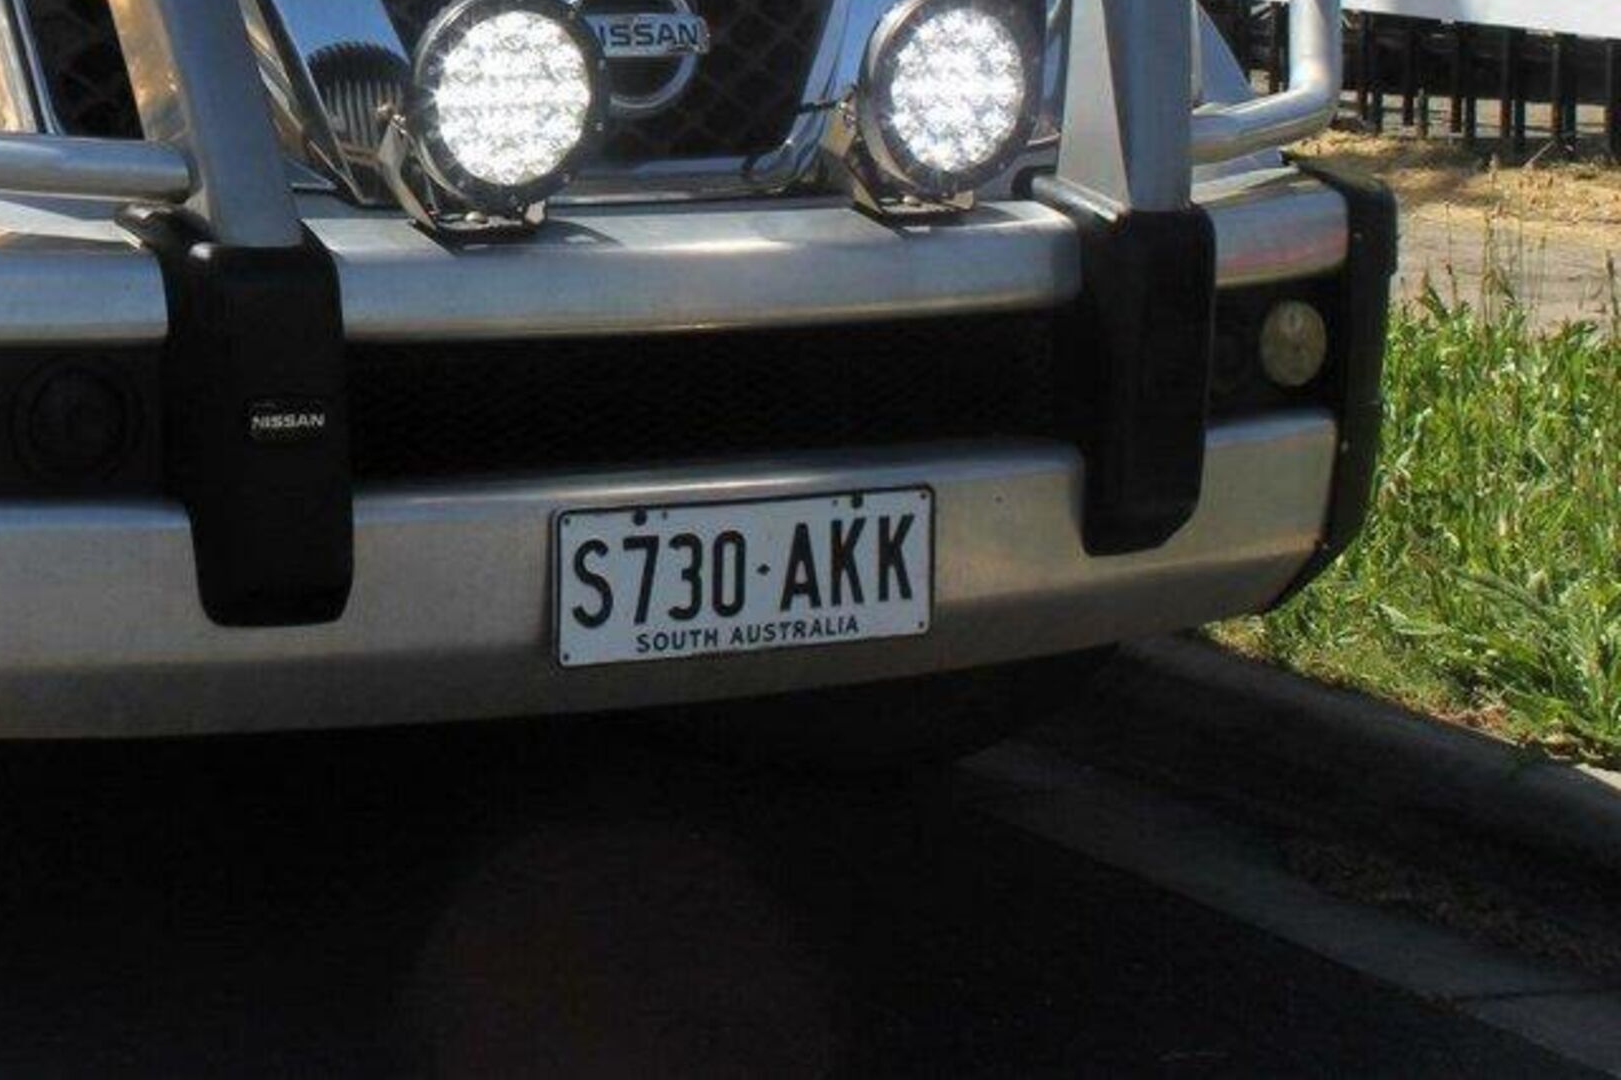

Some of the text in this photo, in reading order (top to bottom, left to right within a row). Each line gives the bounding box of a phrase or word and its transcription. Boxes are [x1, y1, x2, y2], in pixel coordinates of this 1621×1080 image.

[597, 22, 698, 47] ISSAN
[251, 413, 326, 430] NISSAN
[636, 615, 860, 654] SOUTH AUSTRALIA
